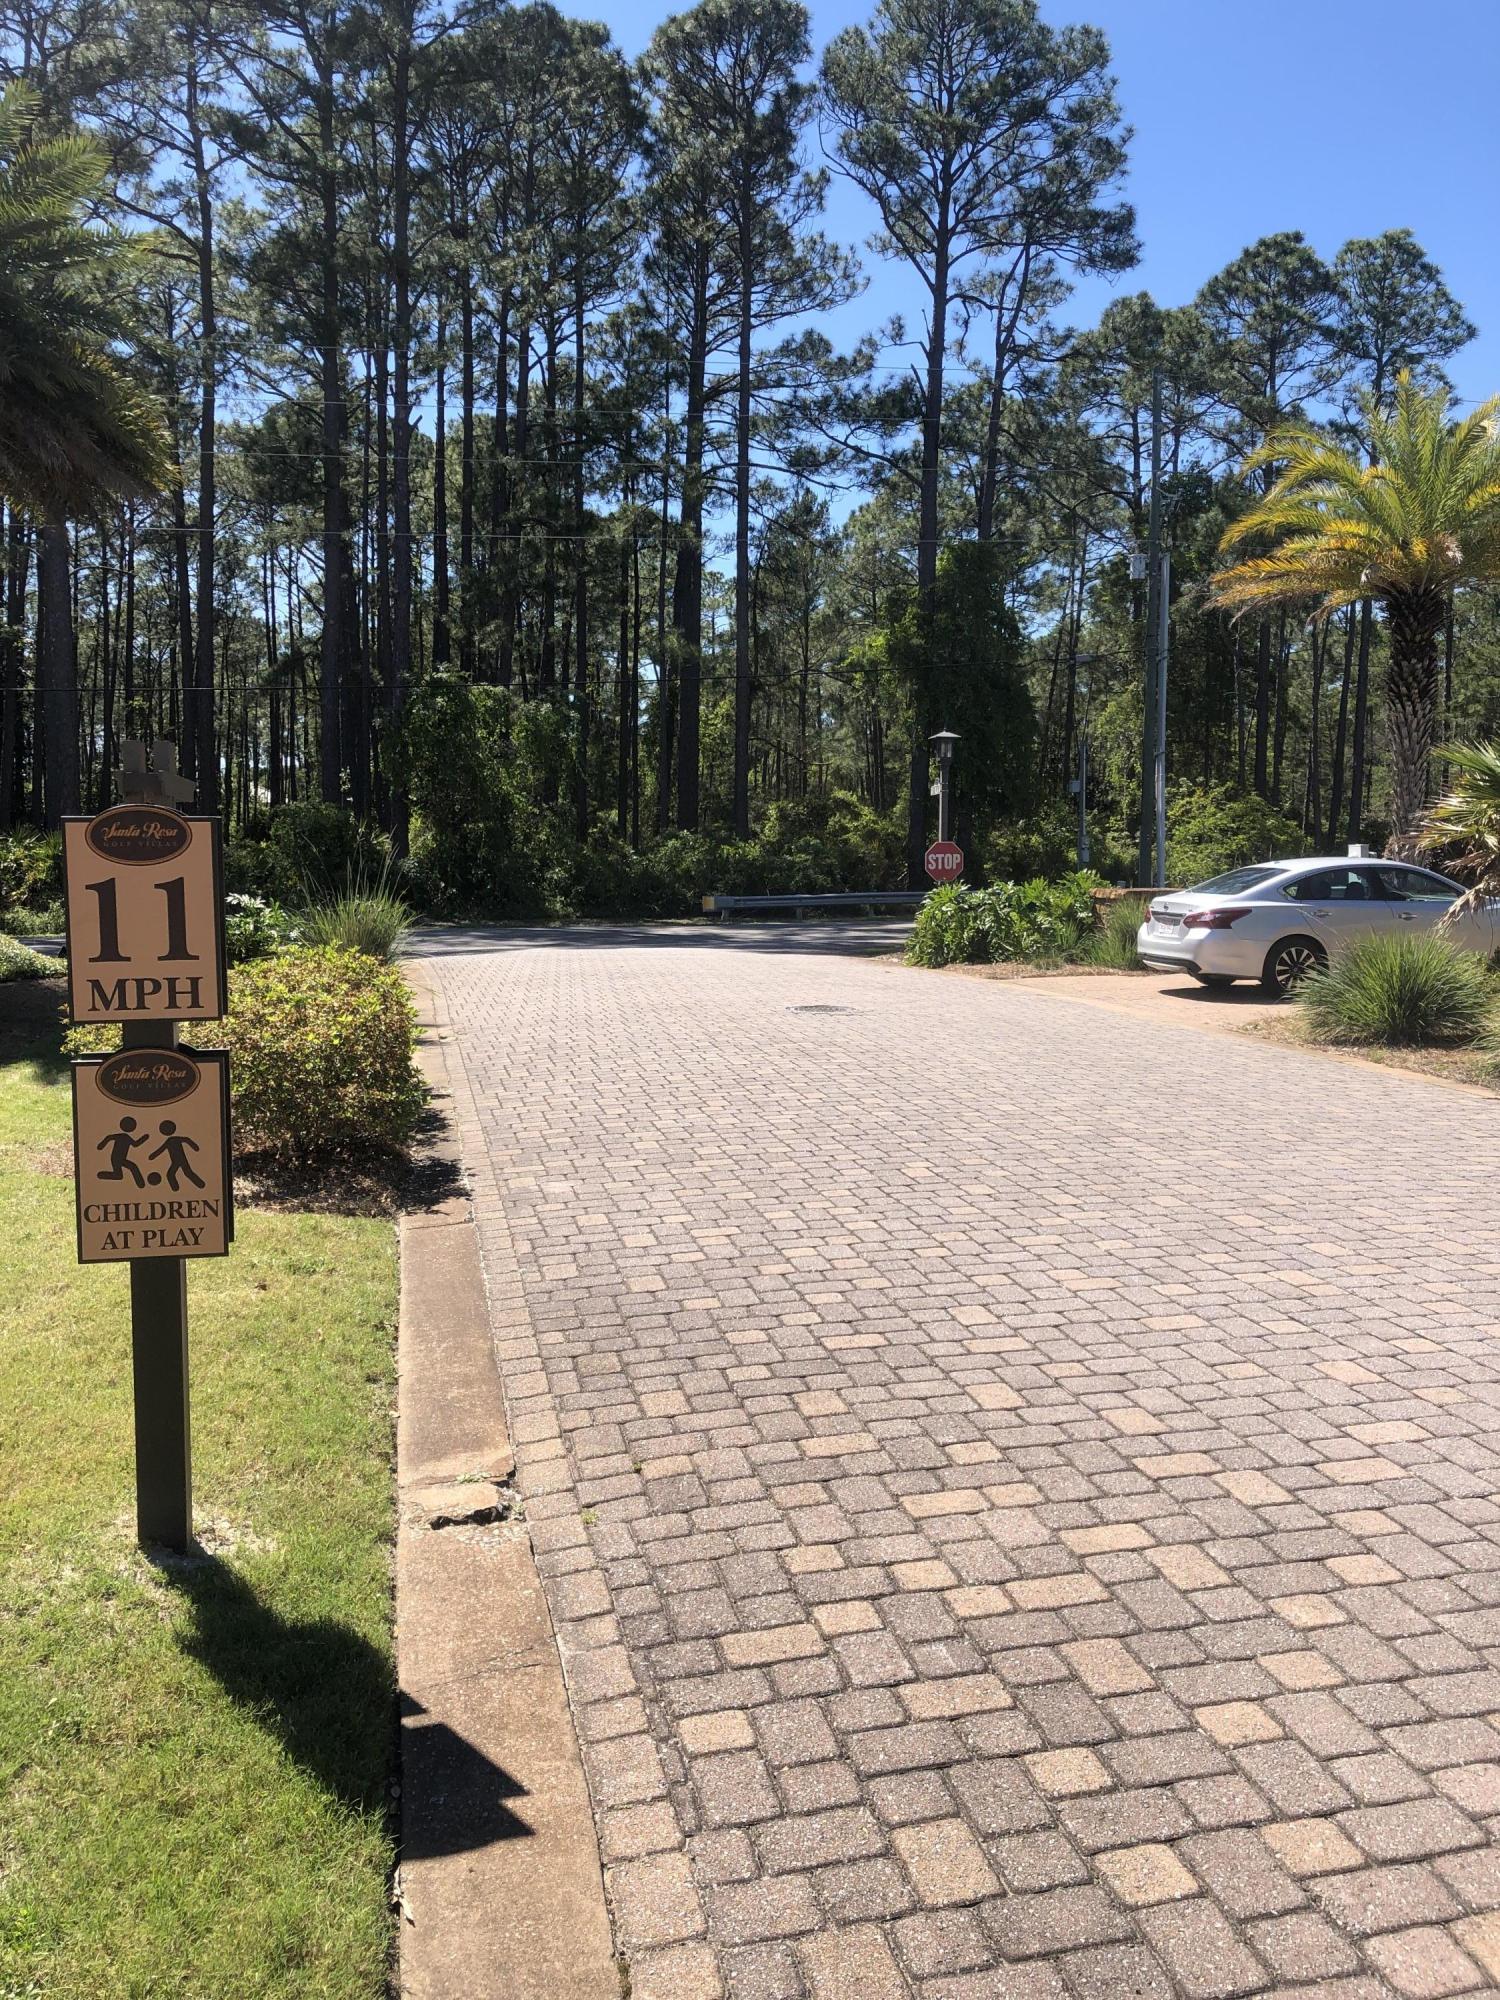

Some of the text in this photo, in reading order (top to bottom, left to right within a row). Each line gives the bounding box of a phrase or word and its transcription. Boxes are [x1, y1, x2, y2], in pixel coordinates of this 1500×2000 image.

[101, 821, 178, 840] Santa Rosa
[928, 853, 960, 870] STOP
[85, 876, 200, 963] 11
[86, 976, 205, 1012] MPH
[111, 1063, 187, 1083] Santa Rosa
[83, 1199, 221, 1223] CHILDREN
[101, 1227, 204, 1250] AT PLAY
